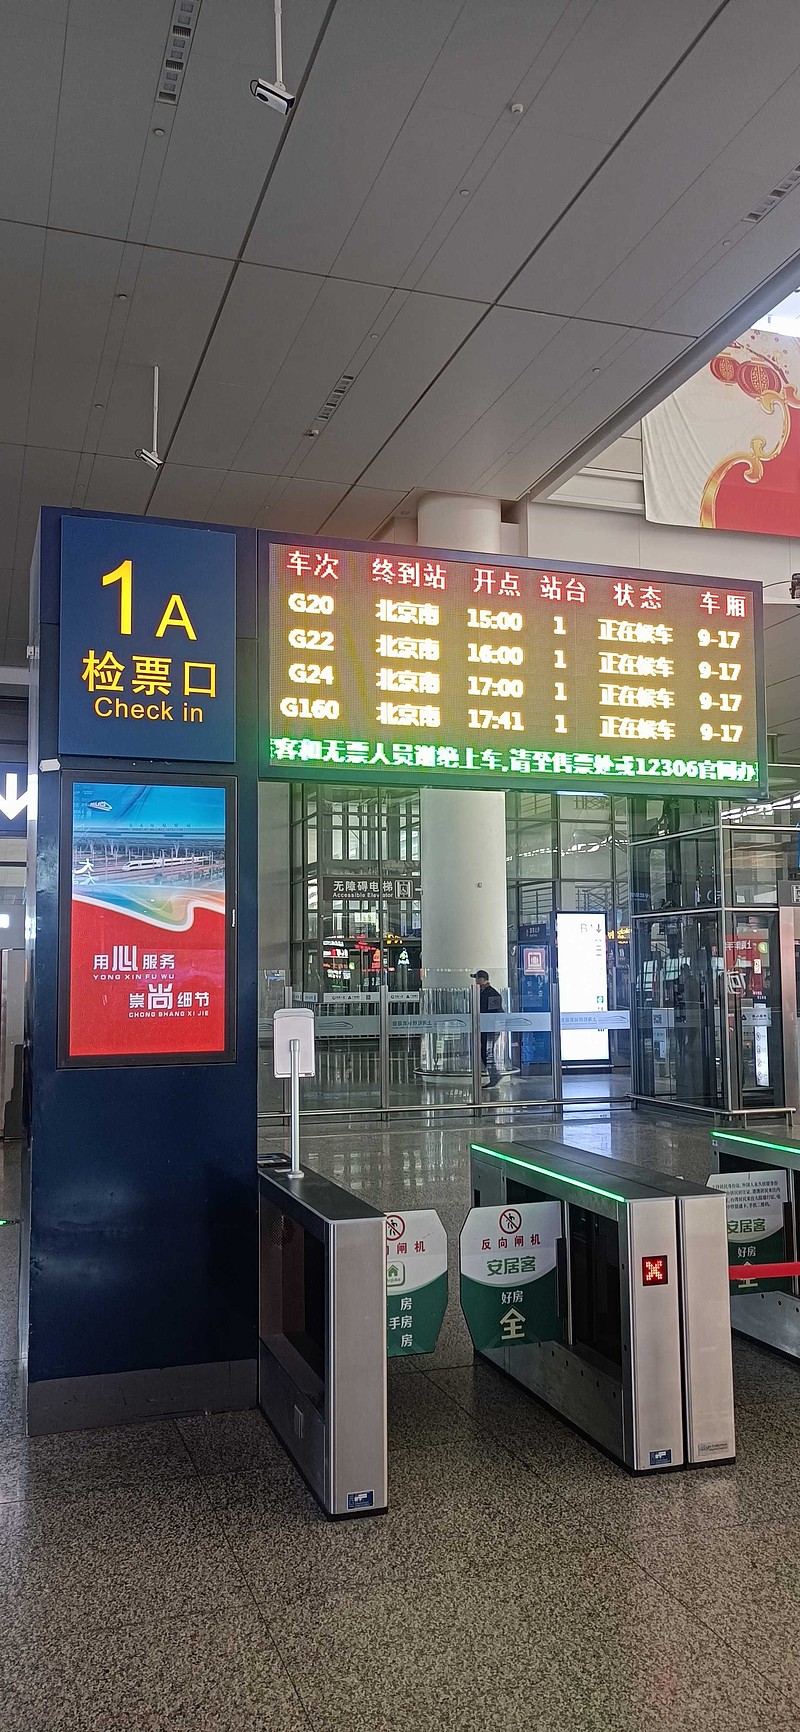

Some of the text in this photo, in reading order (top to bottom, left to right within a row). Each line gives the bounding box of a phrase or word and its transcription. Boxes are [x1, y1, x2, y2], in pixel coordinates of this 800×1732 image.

[287, 551, 746, 617] 车次 终到站 开点 站台 状态 车厢
[288, 593, 740, 648] G20 北京南 15:00 1 正在候车 9-17
[288, 628, 742, 681] G22 北京南 16:00 1 正在候车 9-17
[82, 650, 217, 698] 检票口
[288, 664, 742, 712] G24 北京南 17:00 1 正在候车 9-17
[94, 697, 204, 723] Check in
[280, 697, 743, 743] G160 北京南 17:41 1 正在候车 9-17
[333, 880, 393, 892] 无障碍电梯
[93, 945, 175, 972] 用心服务
[129, 983, 209, 1010] 崇尚细节
[727, 1218, 766, 1234] 安居客
[481, 1234, 541, 1251] 反向闸机
[737, 1246, 757, 1258] 好房
[486, 1256, 536, 1276] 安居客
[400, 1297, 412, 1311] 房
[501, 1290, 524, 1305] 好房
[389, 1315, 413, 1330] 手房
[500, 1306, 526, 1340] 全
[400, 1333, 413, 1348] 房
